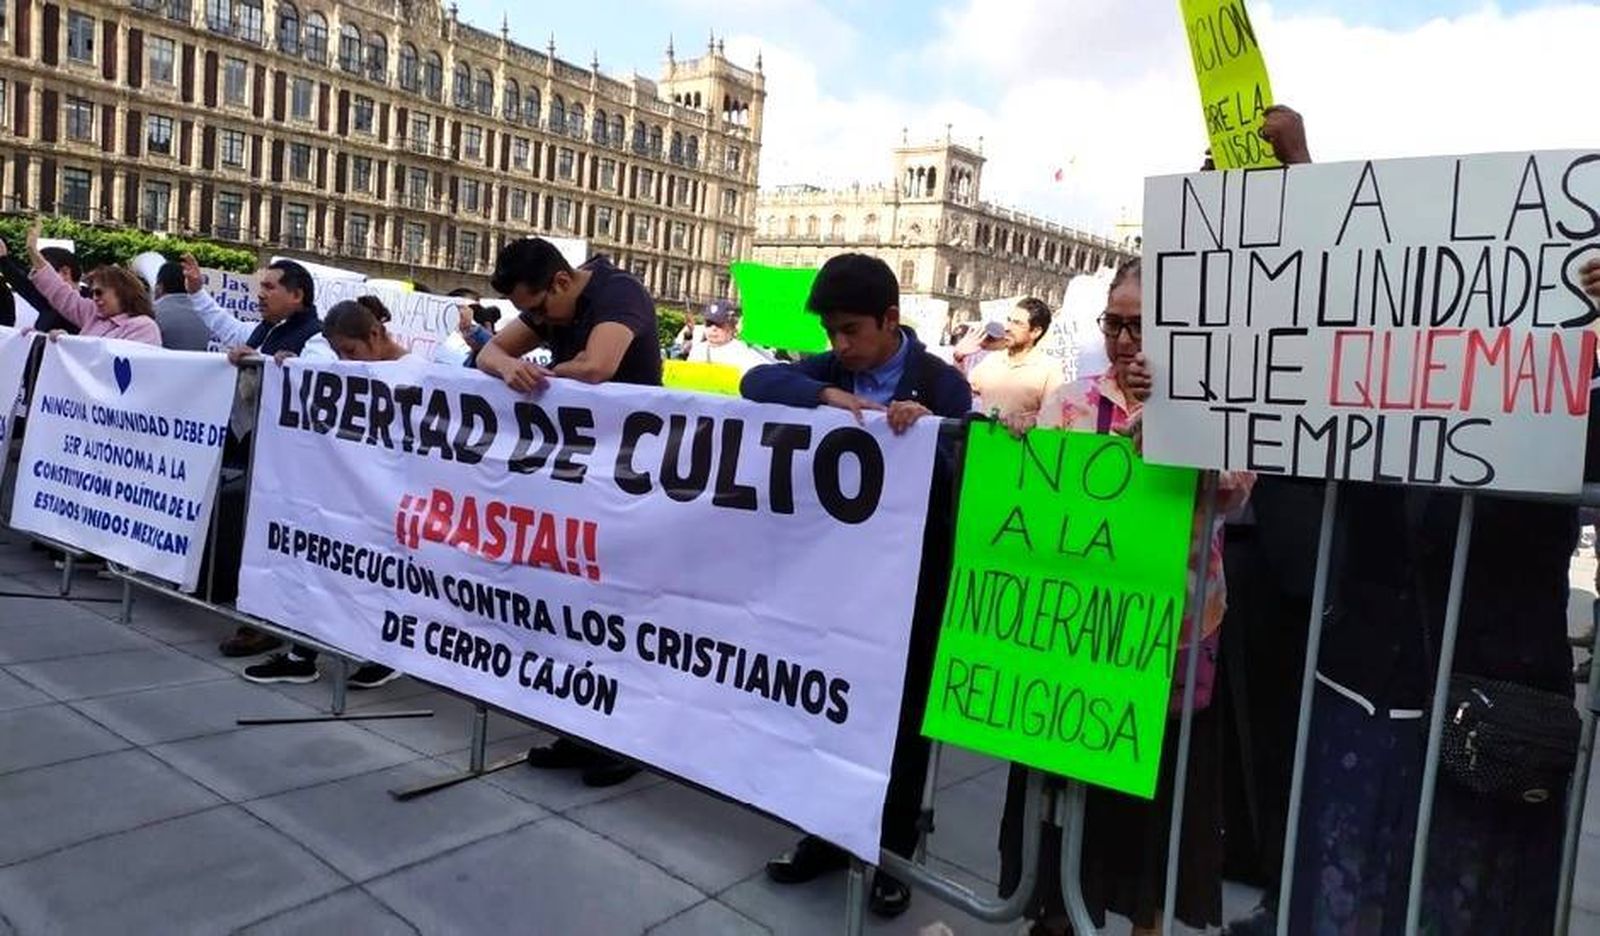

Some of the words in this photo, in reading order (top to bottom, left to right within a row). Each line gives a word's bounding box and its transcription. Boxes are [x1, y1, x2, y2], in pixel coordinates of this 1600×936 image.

[1237, 83, 1265, 126] LA
[1180, 165, 1290, 251] NO
[1335, 160, 1392, 246] A
[1450, 153, 1600, 241] LAS
[223, 273, 249, 292] las
[1155, 243, 1600, 329] COMUNIDADES
[1169, 328, 1308, 405] QUE
[1328, 325, 1598, 416] QUEMAN
[63, 434, 82, 456] SER
[83, 438, 154, 474] AUTÓNOMA
[158, 455, 167, 477] A
[171, 457, 186, 481] LA
[91, 406, 169, 437] COMUNIDAD
[173, 418, 205, 445] DEBE
[279, 366, 498, 465] LIBERTAD
[508, 401, 596, 484] DE
[613, 411, 885, 525] CULTO
[1209, 406, 1496, 486] TEMPLOS
[115, 481, 167, 514] POLÍTICA
[167, 496, 184, 519] DE
[1017, 433, 1133, 501] NO
[33, 491, 80, 520] ESTADOS
[81, 505, 130, 536] UNIDOS
[130, 520, 189, 556] MEXICAN
[989, 504, 1035, 552] A
[1058, 514, 1117, 562] LA
[268, 521, 291, 552] DE
[293, 529, 440, 600] PERSECUCIÓN
[442, 574, 556, 635] CONTRA
[562, 604, 626, 652] LOS
[636, 622, 851, 725] CRISTIANOS
[381, 609, 418, 649] DE
[424, 621, 512, 678] CERRO
[518, 650, 618, 716] CAJÓN
[947, 566, 1177, 679] INTOLERANCIA
[942, 656, 1141, 764] RELIGIOSA
